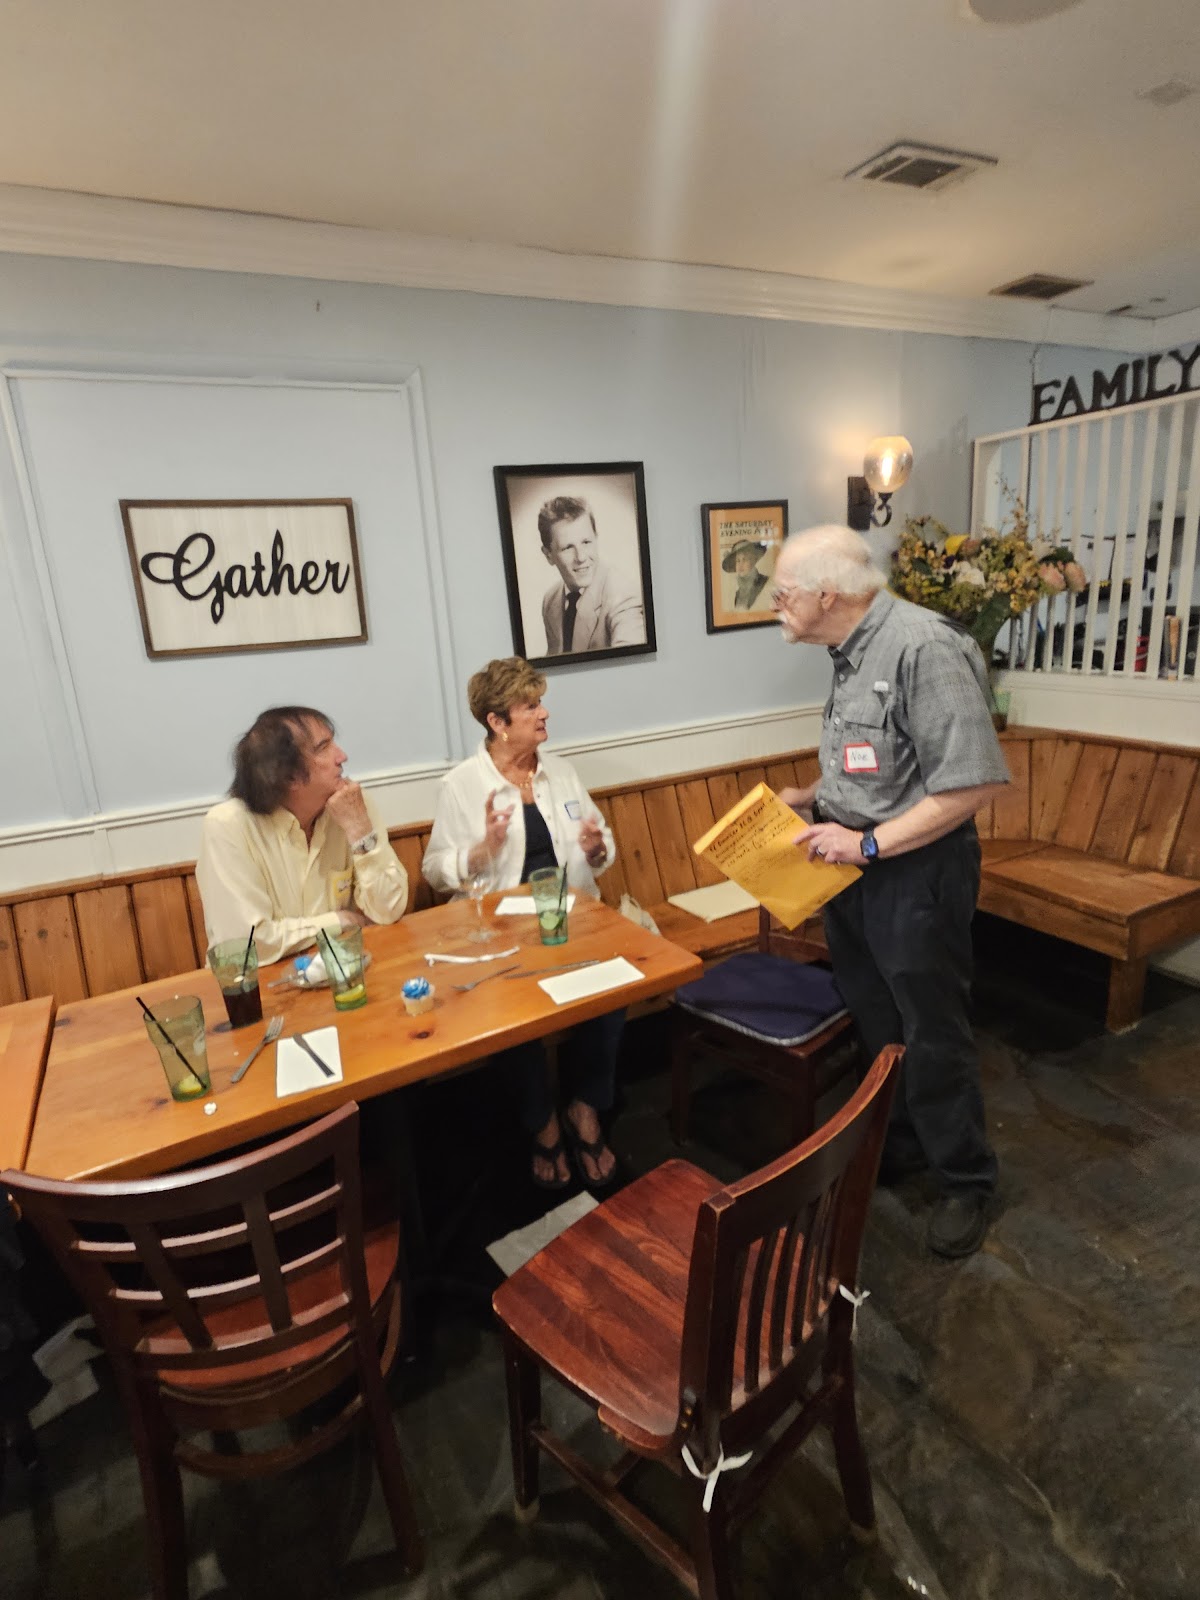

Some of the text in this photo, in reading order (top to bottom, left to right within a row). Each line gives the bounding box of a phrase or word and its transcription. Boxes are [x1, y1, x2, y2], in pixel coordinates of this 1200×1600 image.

[1028, 345, 1200, 426] FAMILY
[720, 520, 772, 529] THE SATURDAY
[720, 527, 773, 537] EVENING PS
[141, 529, 350, 624] Gather
